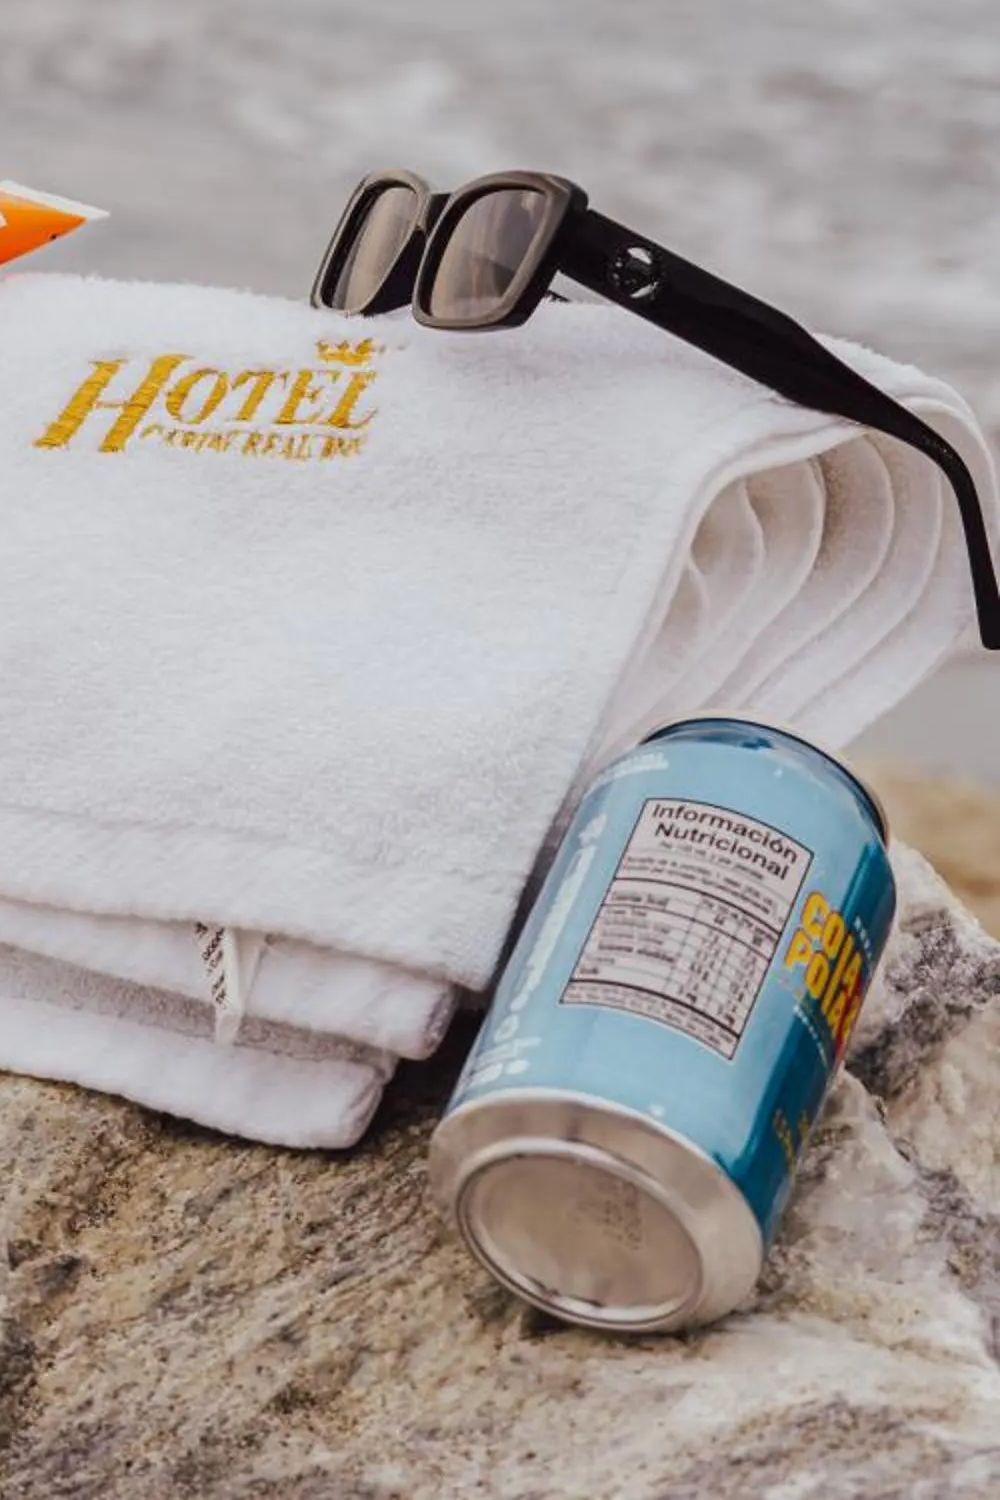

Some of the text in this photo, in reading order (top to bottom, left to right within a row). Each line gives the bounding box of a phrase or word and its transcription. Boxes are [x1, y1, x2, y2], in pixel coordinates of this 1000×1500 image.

[33, 353, 378, 453] HOTEL
[652, 803, 799, 864] Información
[654, 821, 791, 880] Nutricional
